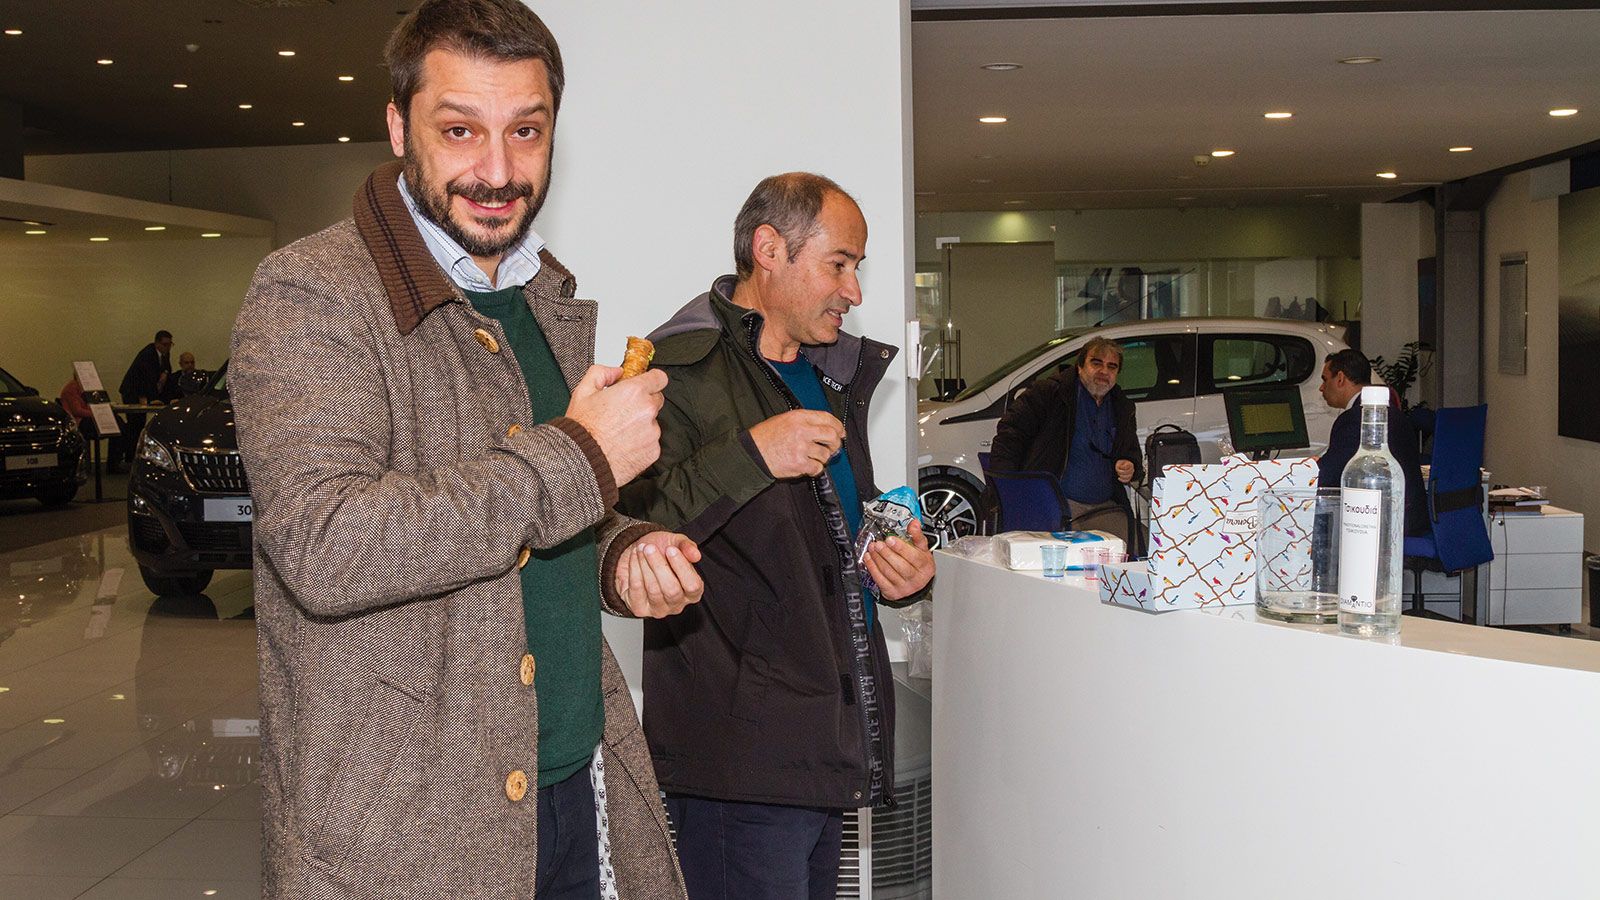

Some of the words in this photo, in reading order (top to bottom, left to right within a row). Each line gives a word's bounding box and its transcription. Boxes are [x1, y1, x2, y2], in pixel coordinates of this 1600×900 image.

[846, 592, 866, 627] TECH
[856, 633, 870, 659] ICE
[862, 675, 878, 713] TECH
[868, 719, 881, 743] ICE
[869, 760, 884, 800] TECH
